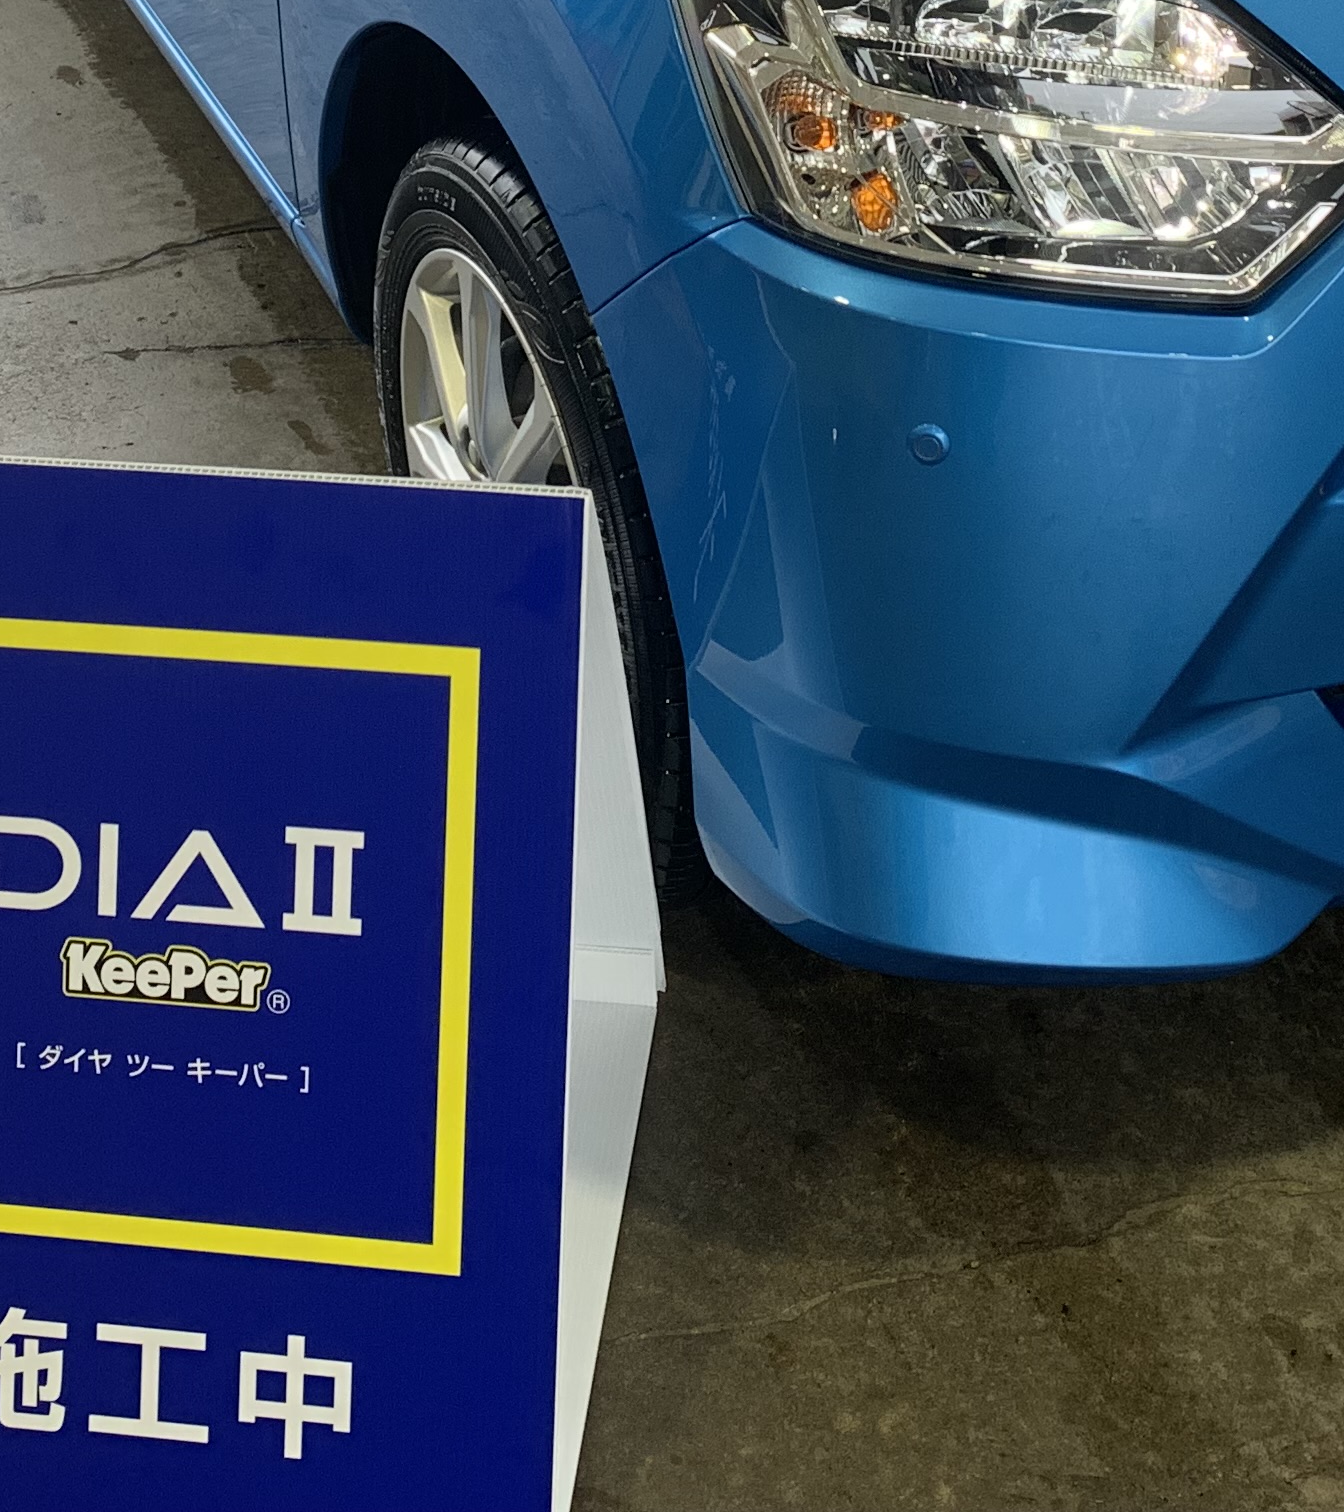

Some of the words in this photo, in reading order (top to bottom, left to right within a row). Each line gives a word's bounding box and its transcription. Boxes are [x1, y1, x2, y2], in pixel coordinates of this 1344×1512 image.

[61, 937, 270, 1011] KeePer
[38, 1044, 113, 1075] ダイヤ
[125, 1053, 175, 1078] ツー
[186, 1057, 289, 1088] キーパー
